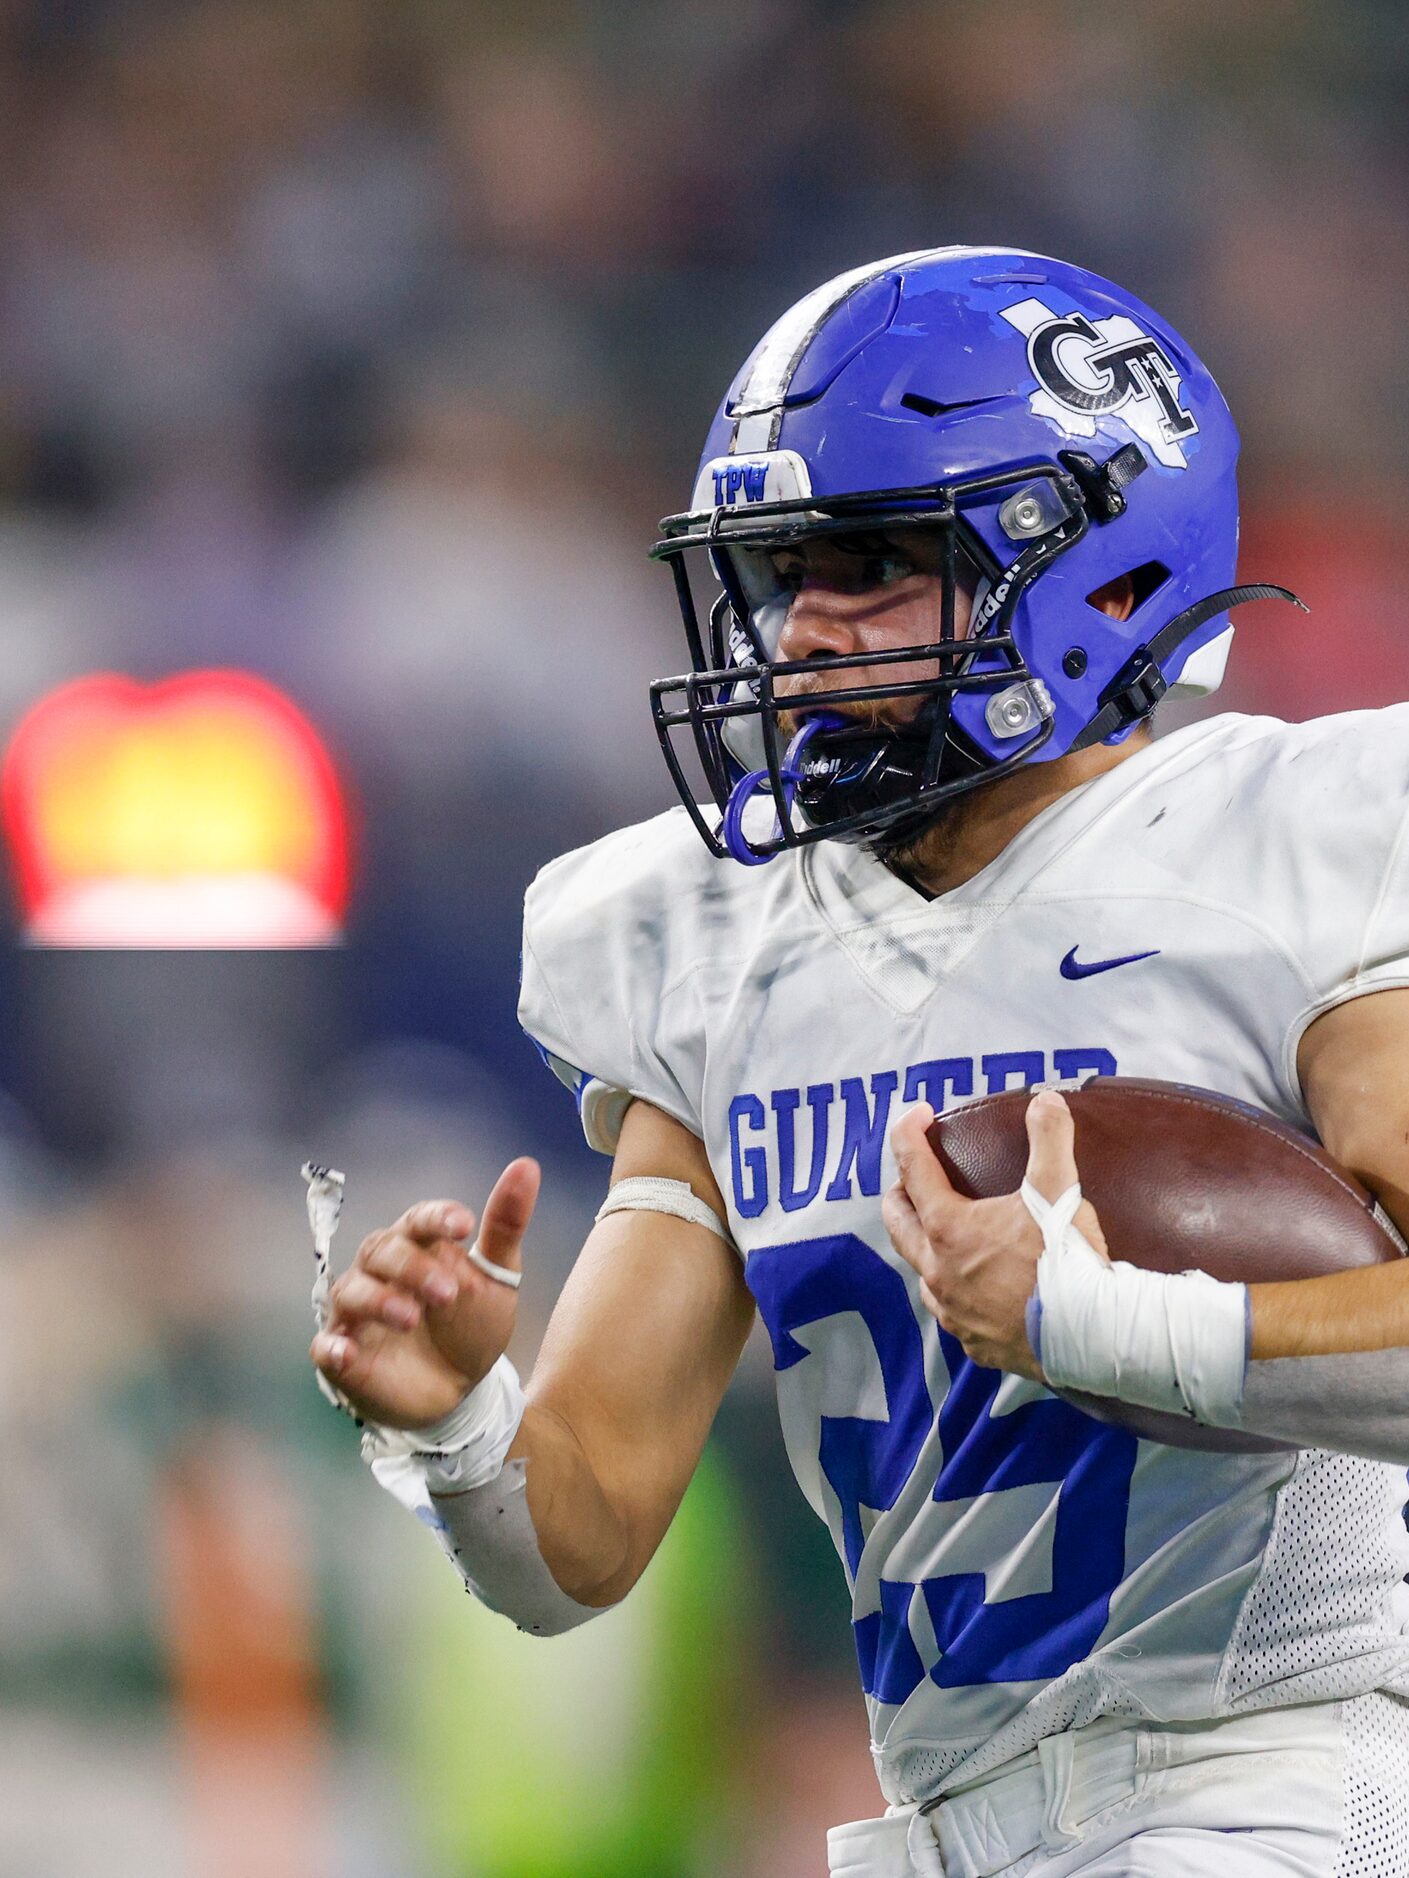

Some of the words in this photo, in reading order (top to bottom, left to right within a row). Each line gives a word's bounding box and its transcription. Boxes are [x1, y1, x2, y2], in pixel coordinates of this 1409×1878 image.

[1027, 311, 1200, 446] GT
[712, 461, 769, 506] TPW
[744, 1233, 1138, 1705] 25
